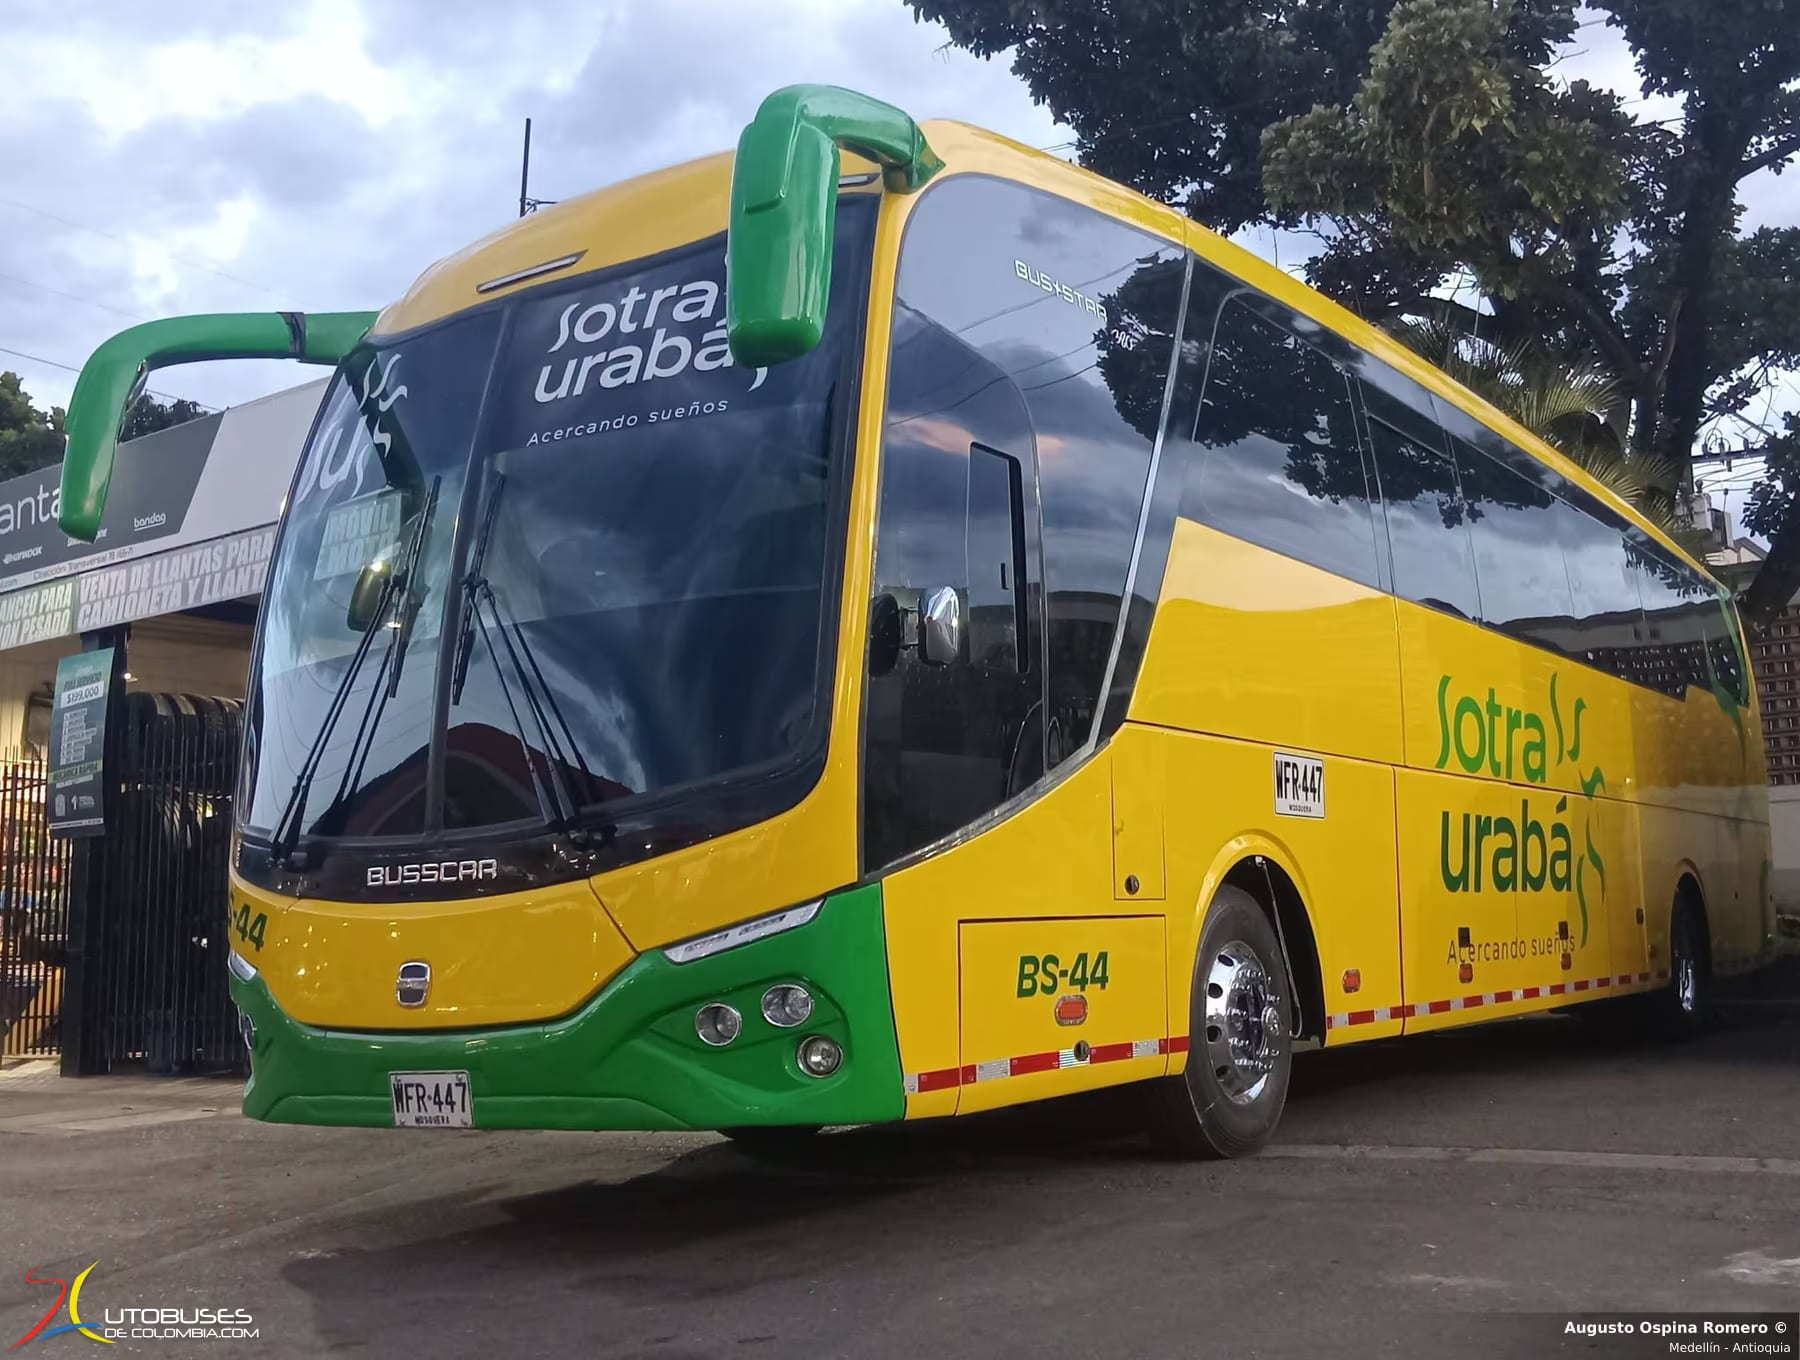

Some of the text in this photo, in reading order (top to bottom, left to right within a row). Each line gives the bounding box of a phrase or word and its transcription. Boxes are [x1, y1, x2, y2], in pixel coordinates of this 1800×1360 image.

[526, 399, 729, 448] Acercando sueños
[133, 511, 167, 531] bandag
[79, 532, 275, 604] VENTA DE LLANTAS PARA
[39, 581, 73, 614] PARA
[77, 581, 184, 628] CAMIONETA
[187, 577, 201, 605] Y
[20, 608, 71, 645] PESADO
[1435, 674, 1547, 784] Sotra
[1441, 795, 1572, 893] urabá
[366, 858, 498, 887] BUSSCAR
[1016, 951, 1109, 999] BS-44
[1446, 936, 1527, 966] Acercando
